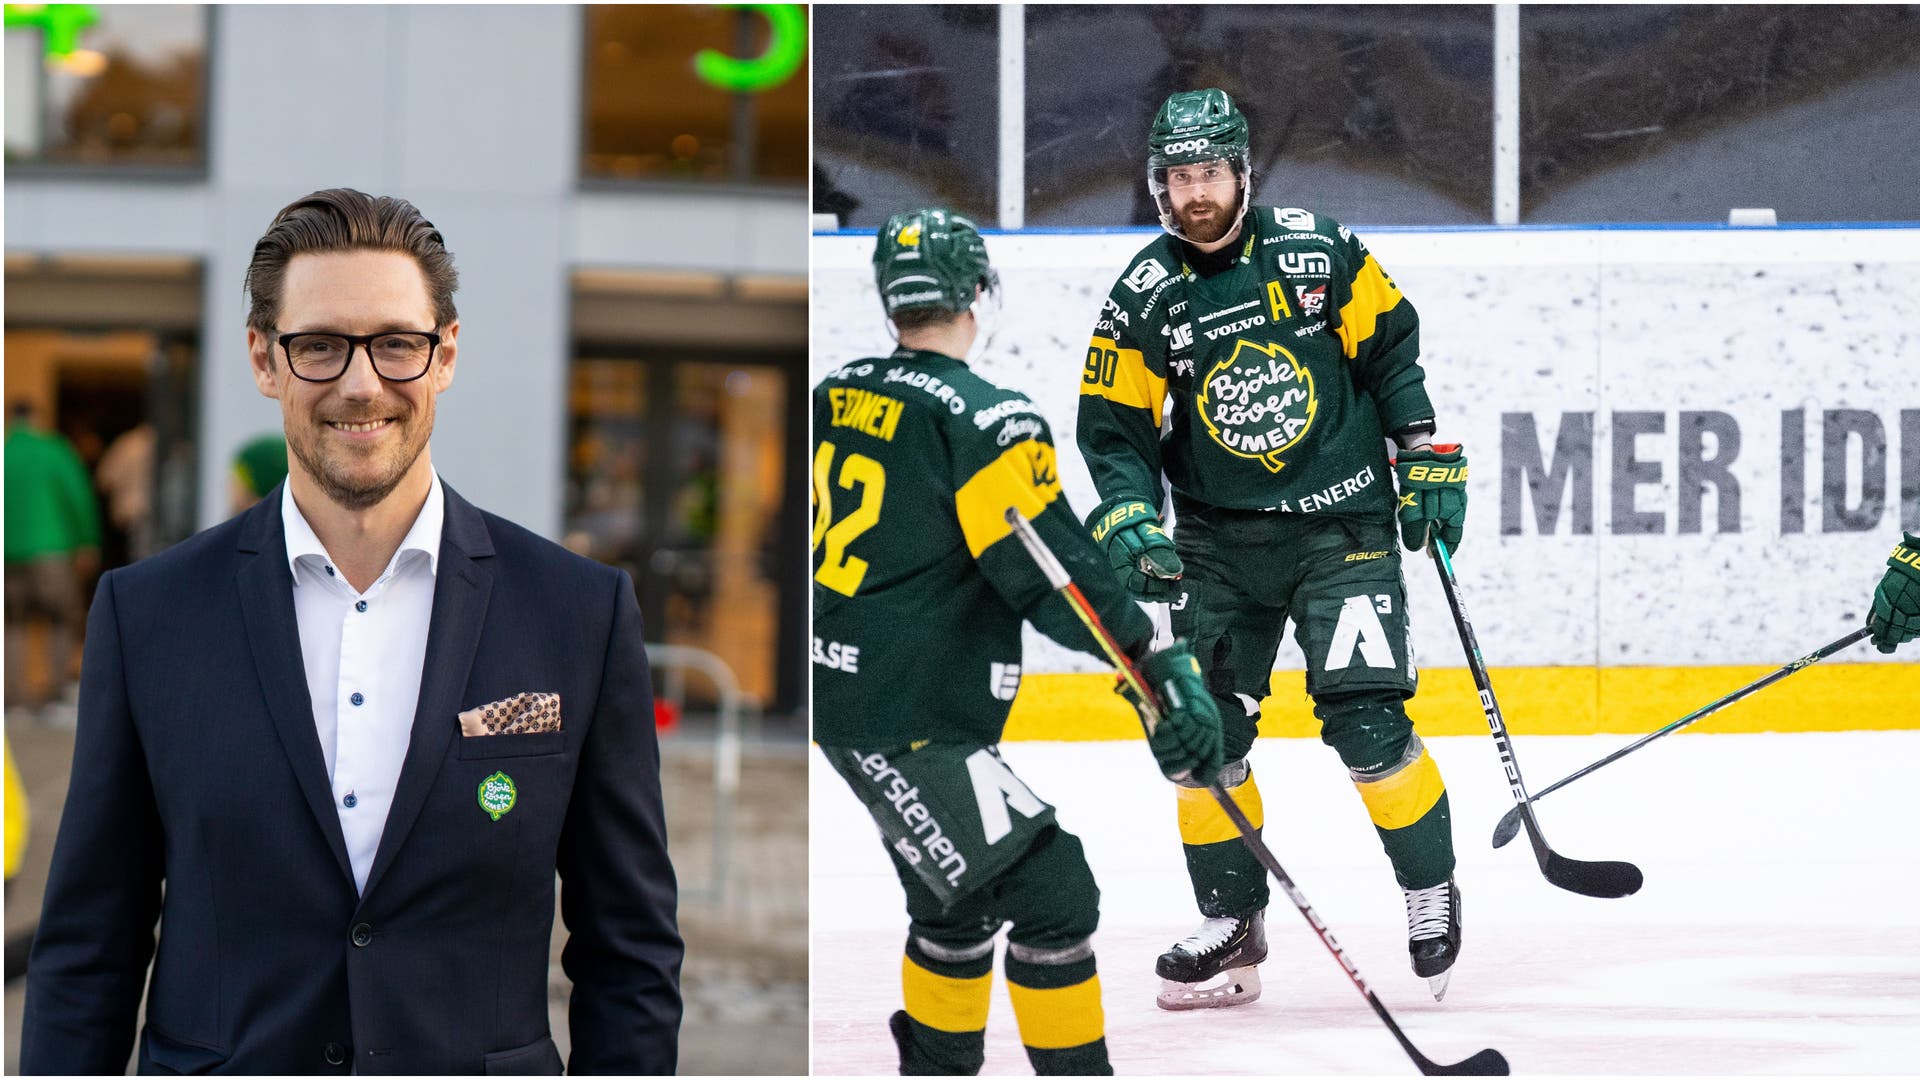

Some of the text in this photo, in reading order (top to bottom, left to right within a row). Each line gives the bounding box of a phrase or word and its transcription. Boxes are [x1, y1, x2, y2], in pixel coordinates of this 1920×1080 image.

[1164, 138, 1209, 155] coop
[1263, 232, 1334, 246] BALTICGRUPPEN
[1266, 280, 1292, 321] A
[1204, 315, 1266, 341] VOLVO
[1083, 346, 1119, 388] 90
[1209, 359, 1296, 405] Björk
[1213, 388, 1308, 425] löven
[1222, 412, 1307, 452] UMEÅ
[1298, 465, 1375, 513] ENERGI
[1501, 410, 1742, 536] MER
[1344, 551, 1389, 562] BAUER
